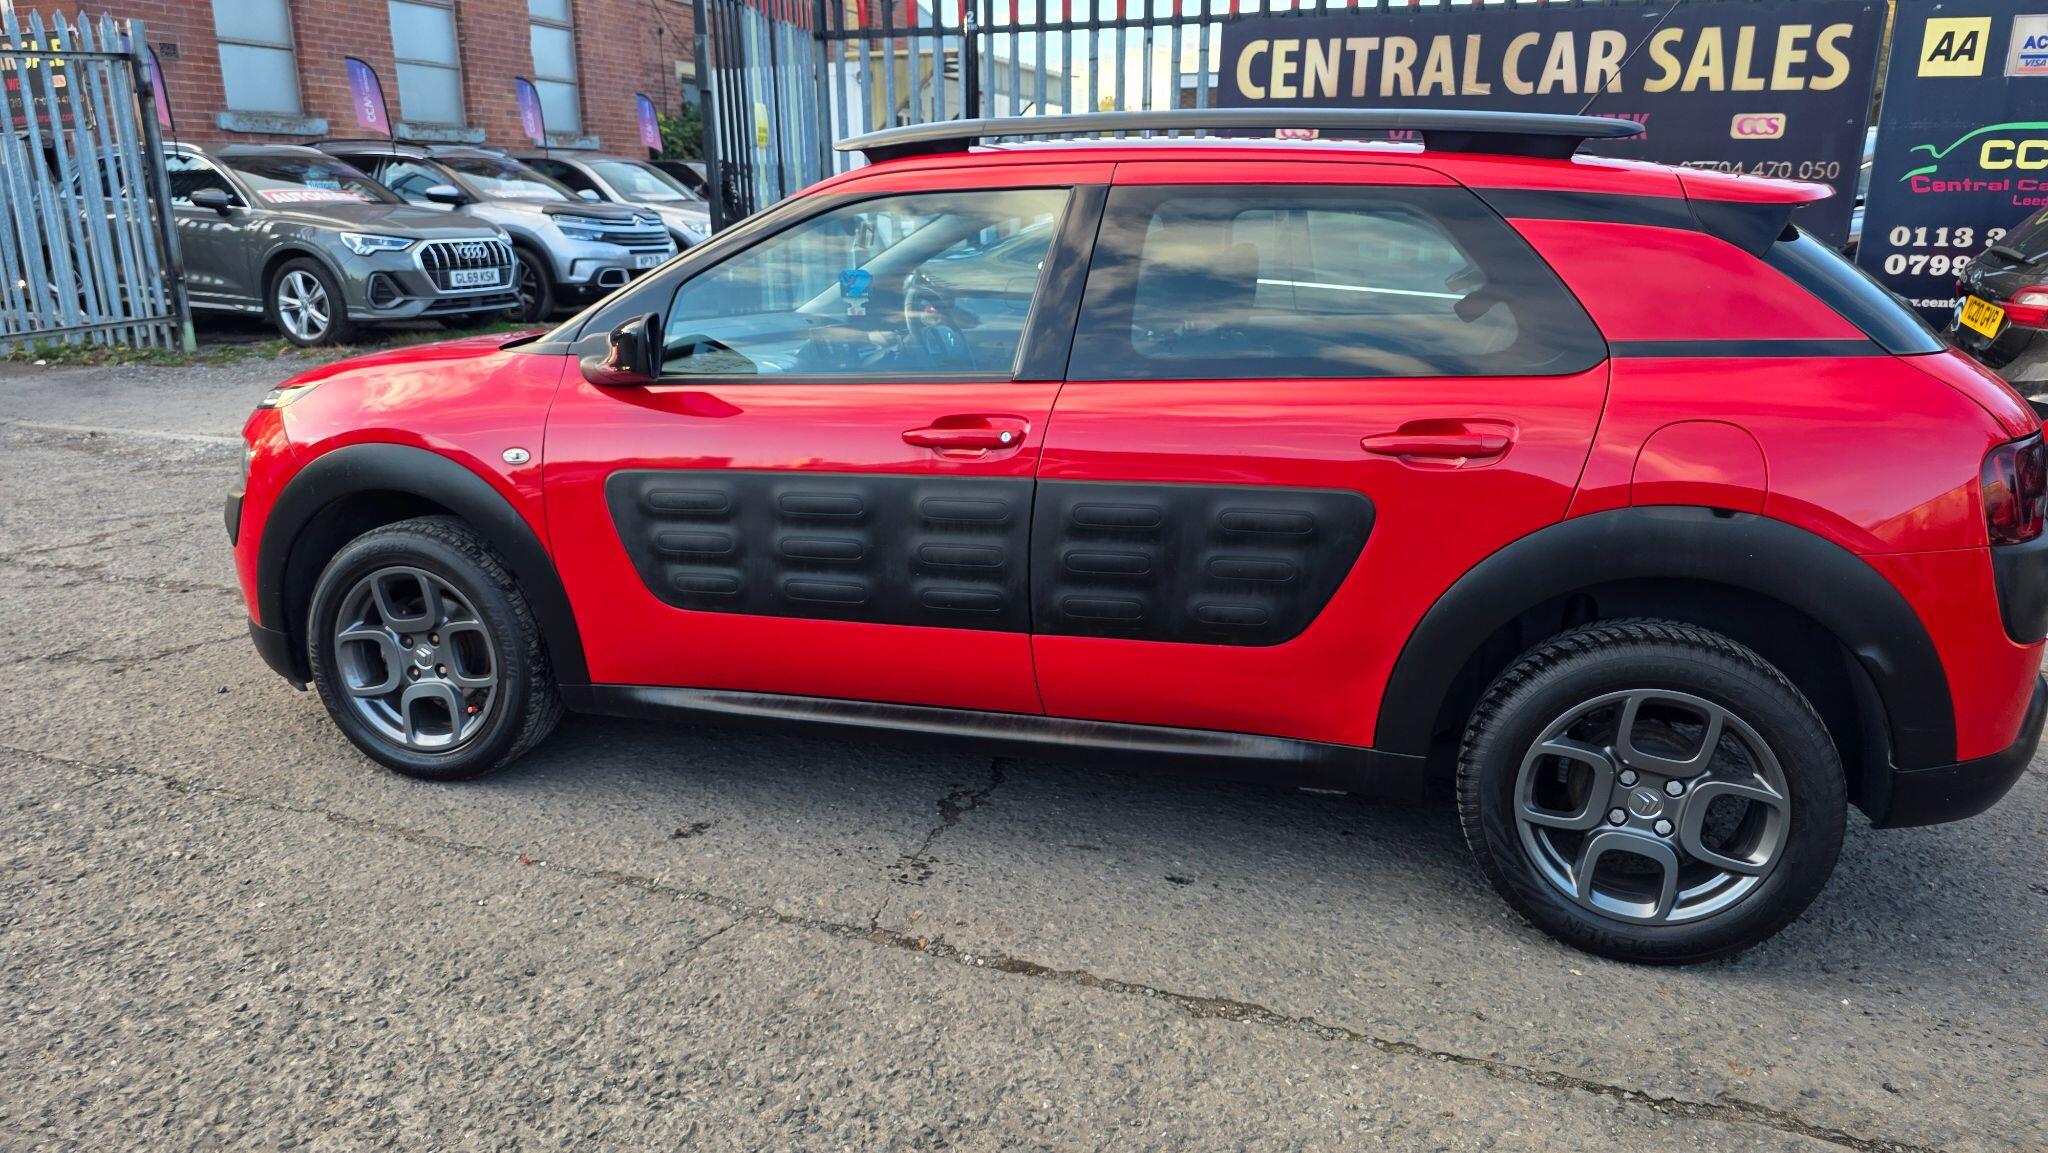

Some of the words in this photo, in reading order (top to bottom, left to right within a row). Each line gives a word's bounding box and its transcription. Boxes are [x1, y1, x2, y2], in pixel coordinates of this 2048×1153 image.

[1927, 31, 1979, 62] AA
[1237, 34, 1491, 99] CENTRAL
[1501, 30, 1628, 95] CAR
[1643, 23, 1854, 93] SALES
[2024, 59, 2047, 67] VISA
[1736, 117, 1780, 136] CCS
[1980, 139, 2048, 170] CC
[1751, 160, 1792, 178] 470
[1799, 160, 1840, 180] 050
[1911, 175, 2010, 193] Central
[1889, 226, 1974, 248] 0113
[1884, 254, 1972, 277] 0799
[455, 272, 479, 284] GL69
[480, 270, 497, 281] KSK
